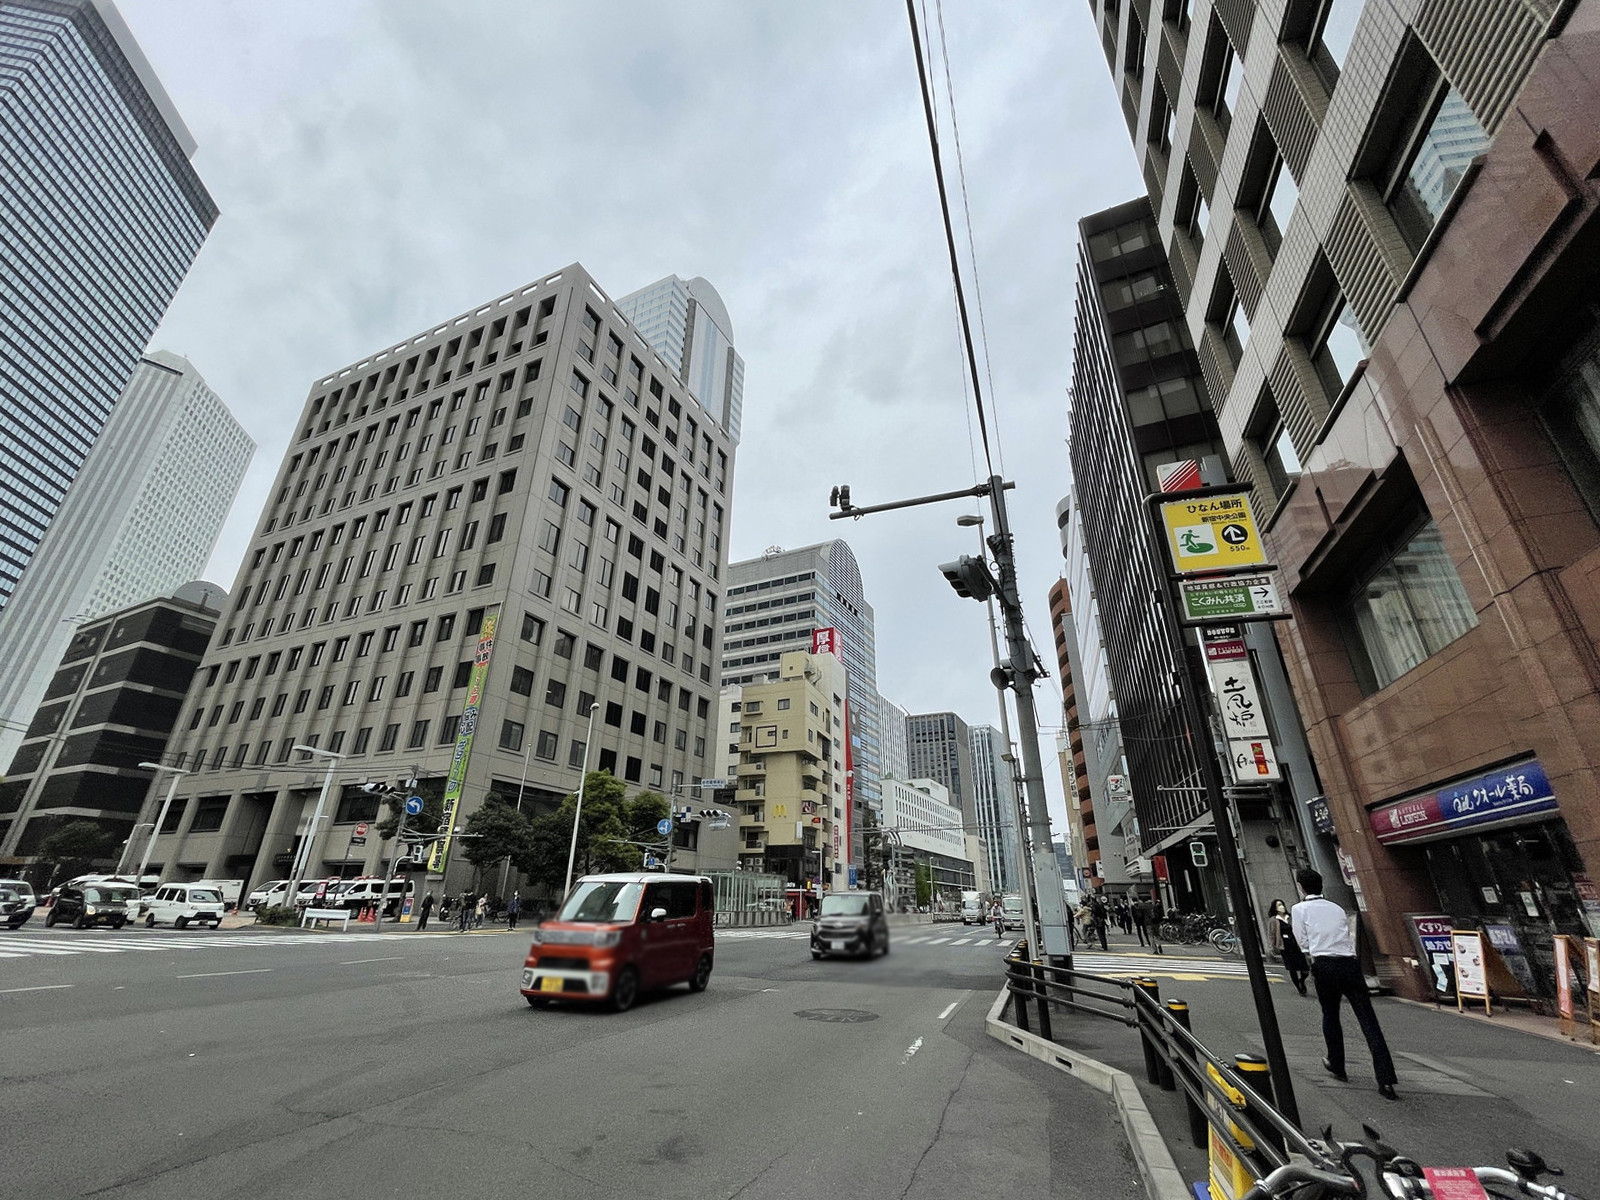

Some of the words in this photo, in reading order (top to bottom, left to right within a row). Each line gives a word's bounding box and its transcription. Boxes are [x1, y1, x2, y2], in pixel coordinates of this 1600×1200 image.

[1186, 498, 1243, 514] ひなん場所
[1201, 511, 1247, 523] 新宿中央公園
[1191, 593, 1246, 607] こくみん共済
[1472, 774, 1534, 806] クオール薬局
[1398, 803, 1425, 815] NATURAL
[1400, 810, 1428, 825] LAWSON
[1418, 922, 1443, 933] くすり
